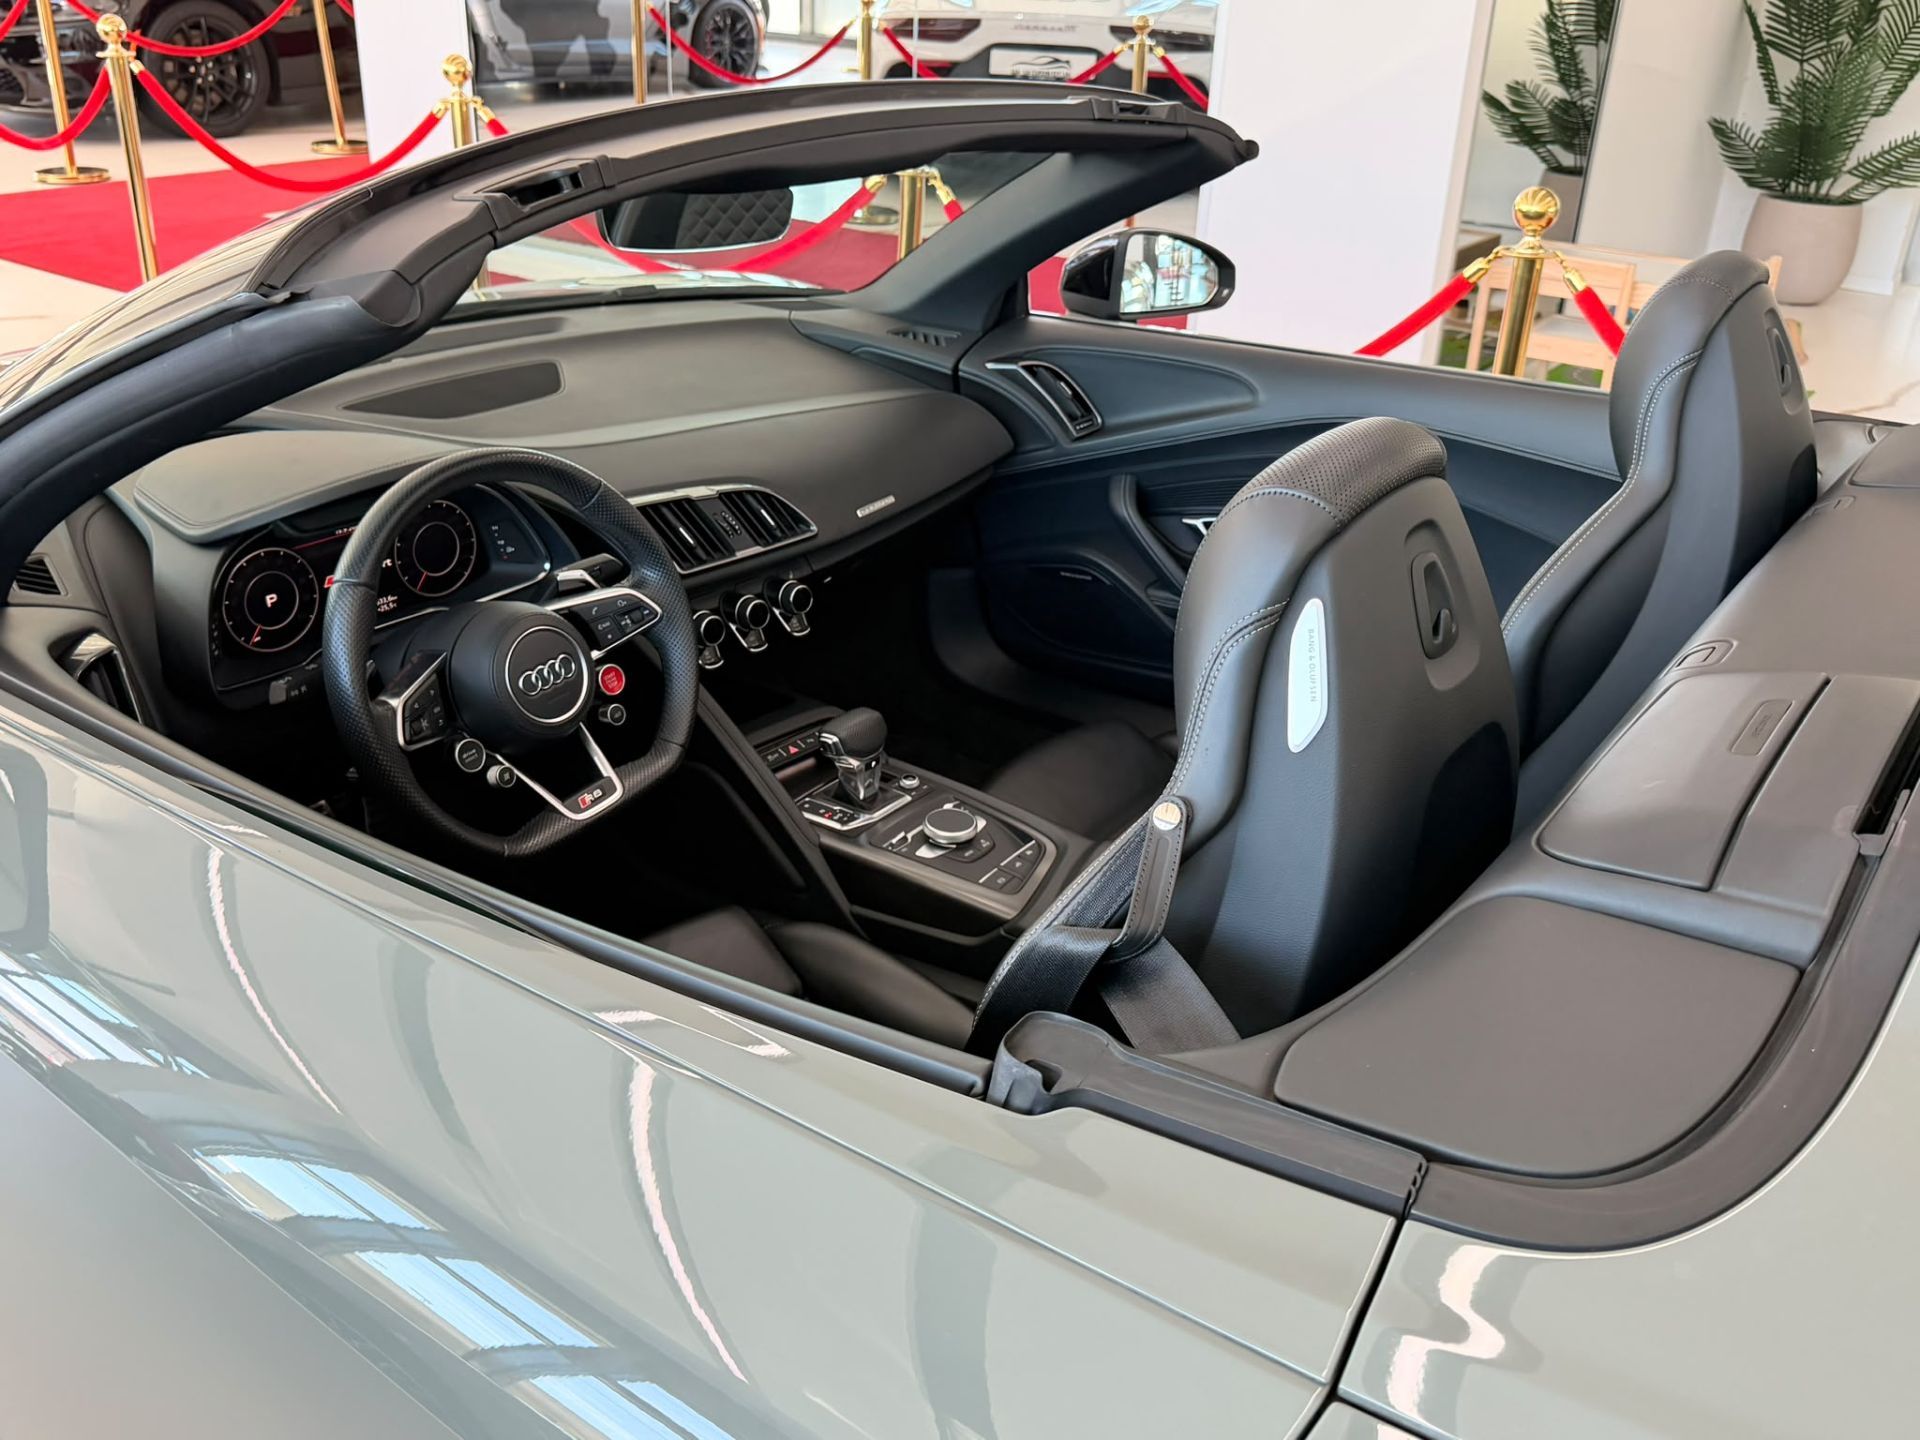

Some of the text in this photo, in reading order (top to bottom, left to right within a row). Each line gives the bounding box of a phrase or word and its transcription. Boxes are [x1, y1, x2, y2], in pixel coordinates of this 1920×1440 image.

[264, 593, 279, 608] P
[1307, 628, 1316, 653] BANG
[1308, 663, 1317, 702] OLUFSEN
